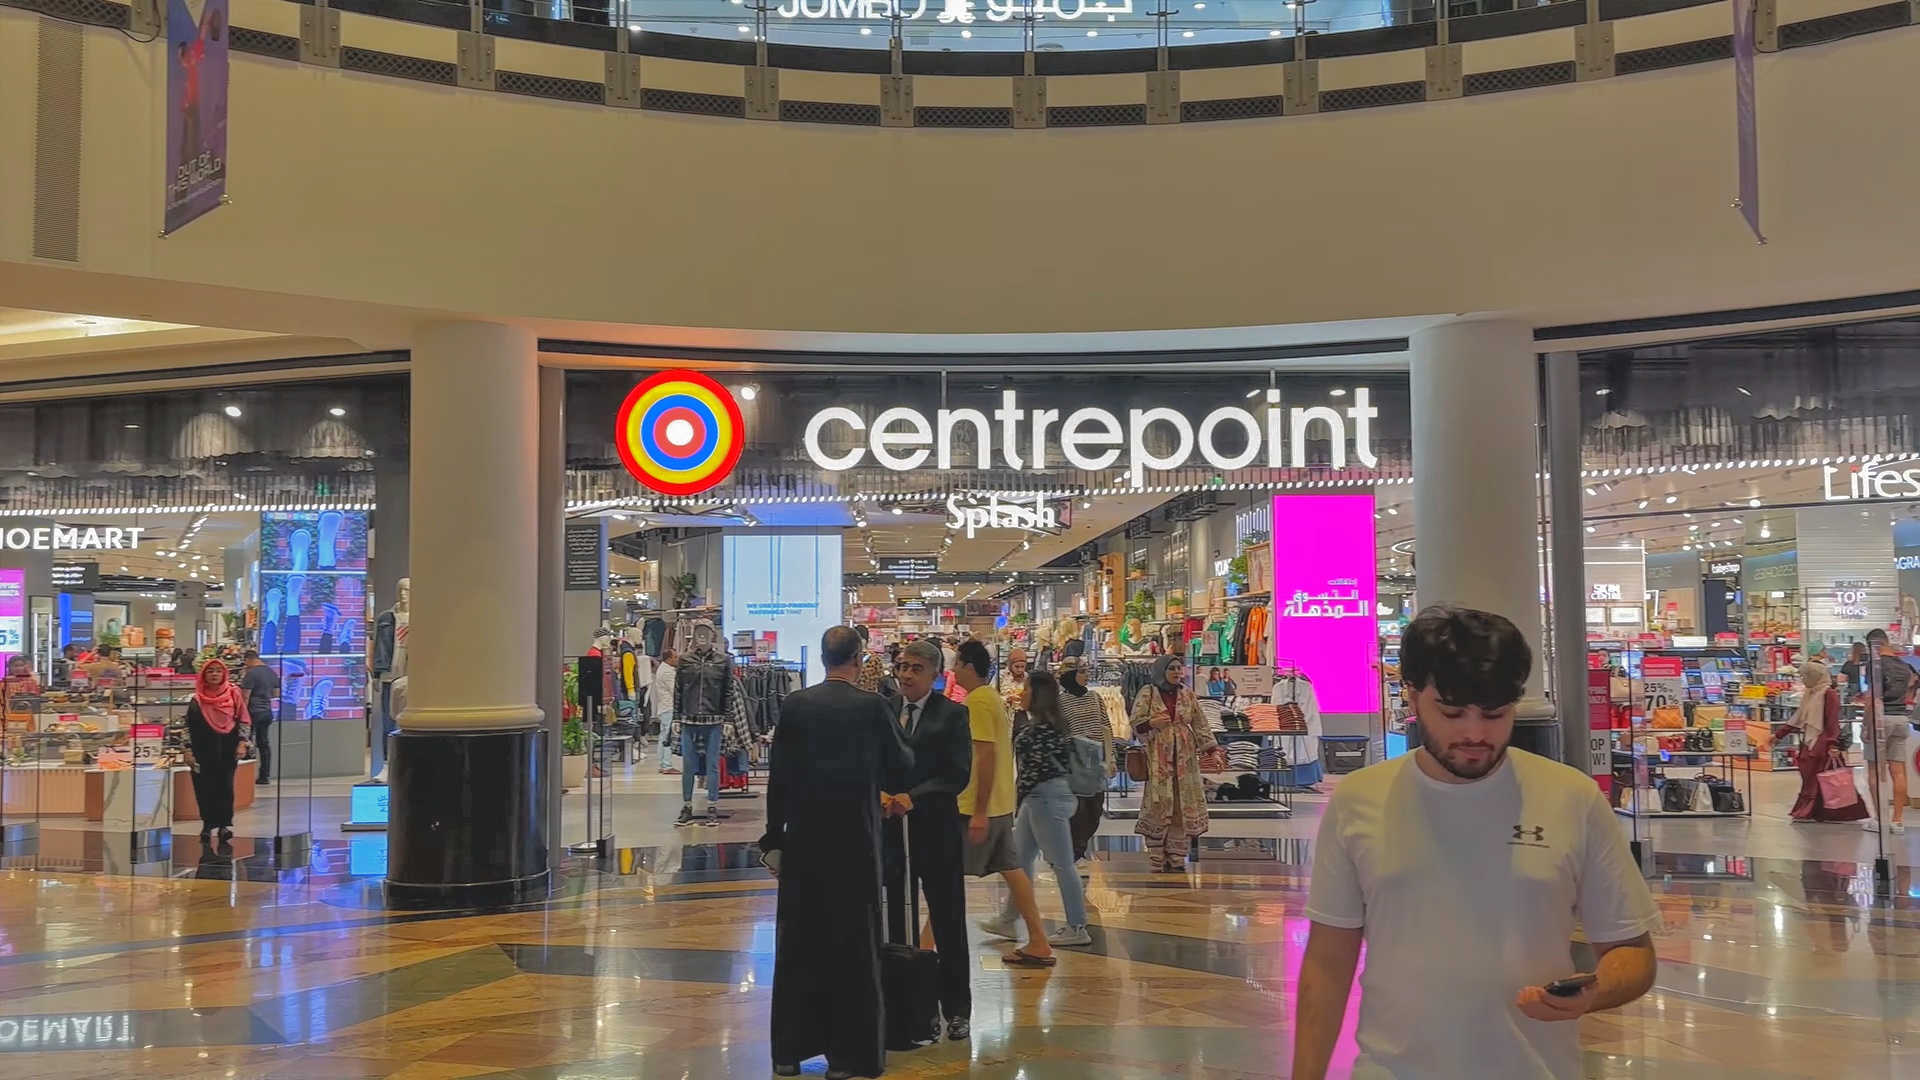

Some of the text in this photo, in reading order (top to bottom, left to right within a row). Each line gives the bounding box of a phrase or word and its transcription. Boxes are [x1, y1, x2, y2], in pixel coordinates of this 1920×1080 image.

[178, 158, 197, 179] OUT
[804, 387, 1379, 488] centrepoint
[945, 490, 1055, 539] Splash
[1837, 591, 1867, 603] TOP
[1730, 738, 1741, 748] 69
